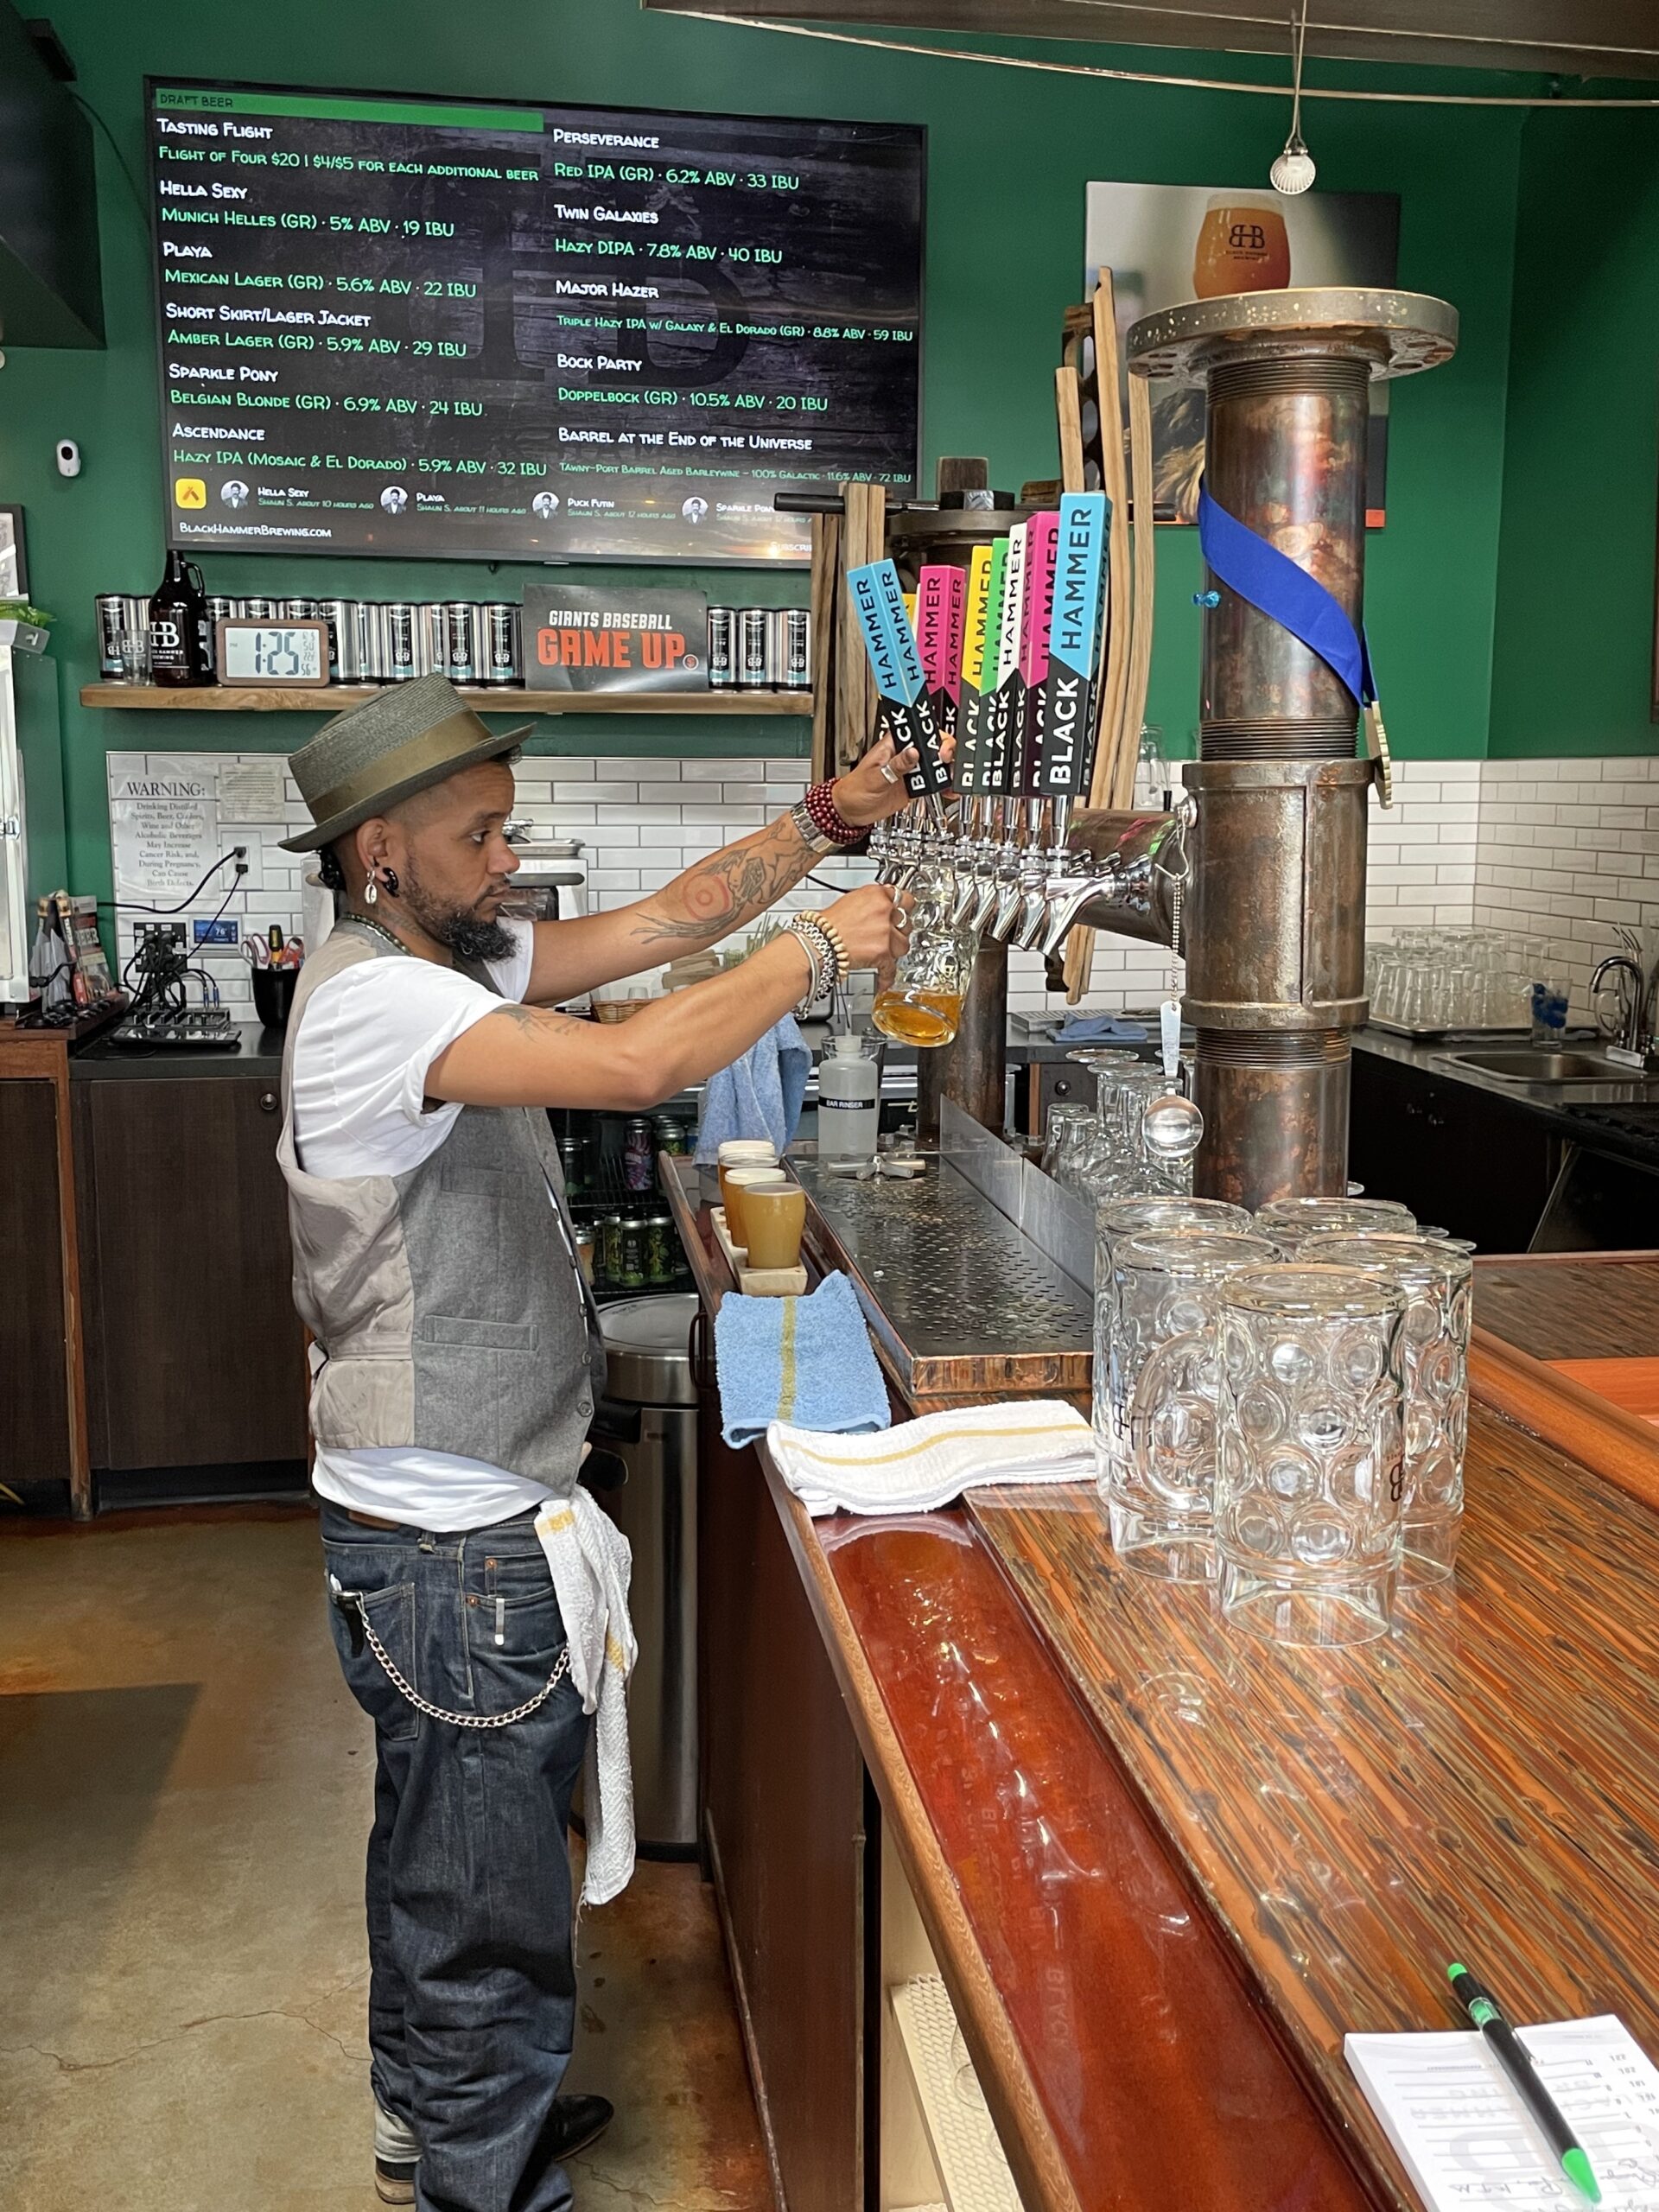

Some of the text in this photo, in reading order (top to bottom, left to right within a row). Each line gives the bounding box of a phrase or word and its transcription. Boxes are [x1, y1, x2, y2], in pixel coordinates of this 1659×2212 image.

[161, 94, 233, 109] DRAFT BEER
[156, 118, 273, 138] TASTING FLIGHT
[553, 129, 659, 148] PERSEVERANCE
[159, 145, 539, 181] FLIGHT OF FOUR $20 $4/$5 FOR EACH ADDITIONAL BEER
[554, 162, 798, 189] RED IPA (GR) 6.2% ABV 33 IBU
[160, 180, 248, 199] HELLA SEXY
[162, 207, 454, 237] MUNICH HELLES (GR) 5% ABV 19 IBU
[553, 204, 658, 224] TWIN GALAXIES
[162, 241, 213, 257] PLAYA
[555, 238, 782, 263] HAZY DIPA 7.8% ABV 40 IBU
[165, 269, 476, 297] MEXICAN LAGER (GR) 5.6% ABV 22 IBU
[556, 280, 659, 298] MAJOR HAZER
[166, 302, 372, 327] SHORT SKIRT/LAGER JACKET
[556, 315, 591, 327] TRIPLE
[594, 316, 623, 328] HAZY
[626, 318, 646, 329] IPA
[648, 320, 663, 330] W/
[664, 320, 704, 332] GALAXY
[719, 322, 733, 334] EL
[735, 323, 777, 335] DORADO
[779, 325, 804, 336] (GR)
[812, 327, 840, 338] 8.8%
[842, 328, 865, 339] ABV
[873, 329, 889, 340] 59
[892, 330, 912, 341] IBU
[168, 329, 467, 357] AMBER LAGER (GR) 5.9% ABV 29 IBU
[168, 363, 278, 382] SPARKLE PONY
[556, 353, 642, 371] BOCK PARTY
[170, 390, 482, 416] BELGIAN BLONDE (GR) 6.9% ABV 24 IBU
[557, 387, 828, 410] DOPPELBOCK (GR) 10.5% ABV 20 IBU
[172, 423, 264, 440] ASCENDANCE
[558, 427, 812, 450] BARREL AT THE END OF THE UNIVERSE
[174, 449, 546, 476] HAZY IPA (MOSAIC & EL DORADO) 5.9% ABV 32 IBU
[179, 522, 332, 537] BLACKHAMMERBREWING.COM
[549, 610, 672, 630] GIANTS BASEBALL
[881, 571, 919, 681] HAMMER
[925, 578, 940, 683] HAMMER
[949, 579, 961, 684] HAMMER
[856, 579, 897, 689] HAMMER
[1049, 508, 1092, 785] BLACK HAMMER
[256, 631, 299, 676] 1:25
[537, 628, 631, 668] GAME
[641, 632, 685, 669] UP
[1013, 531, 1033, 788] BLACK HAMMER
[992, 691, 1009, 786] BLACK
[1003, 539, 1021, 664] HAMMER
[126, 782, 206, 796] WARNING:
